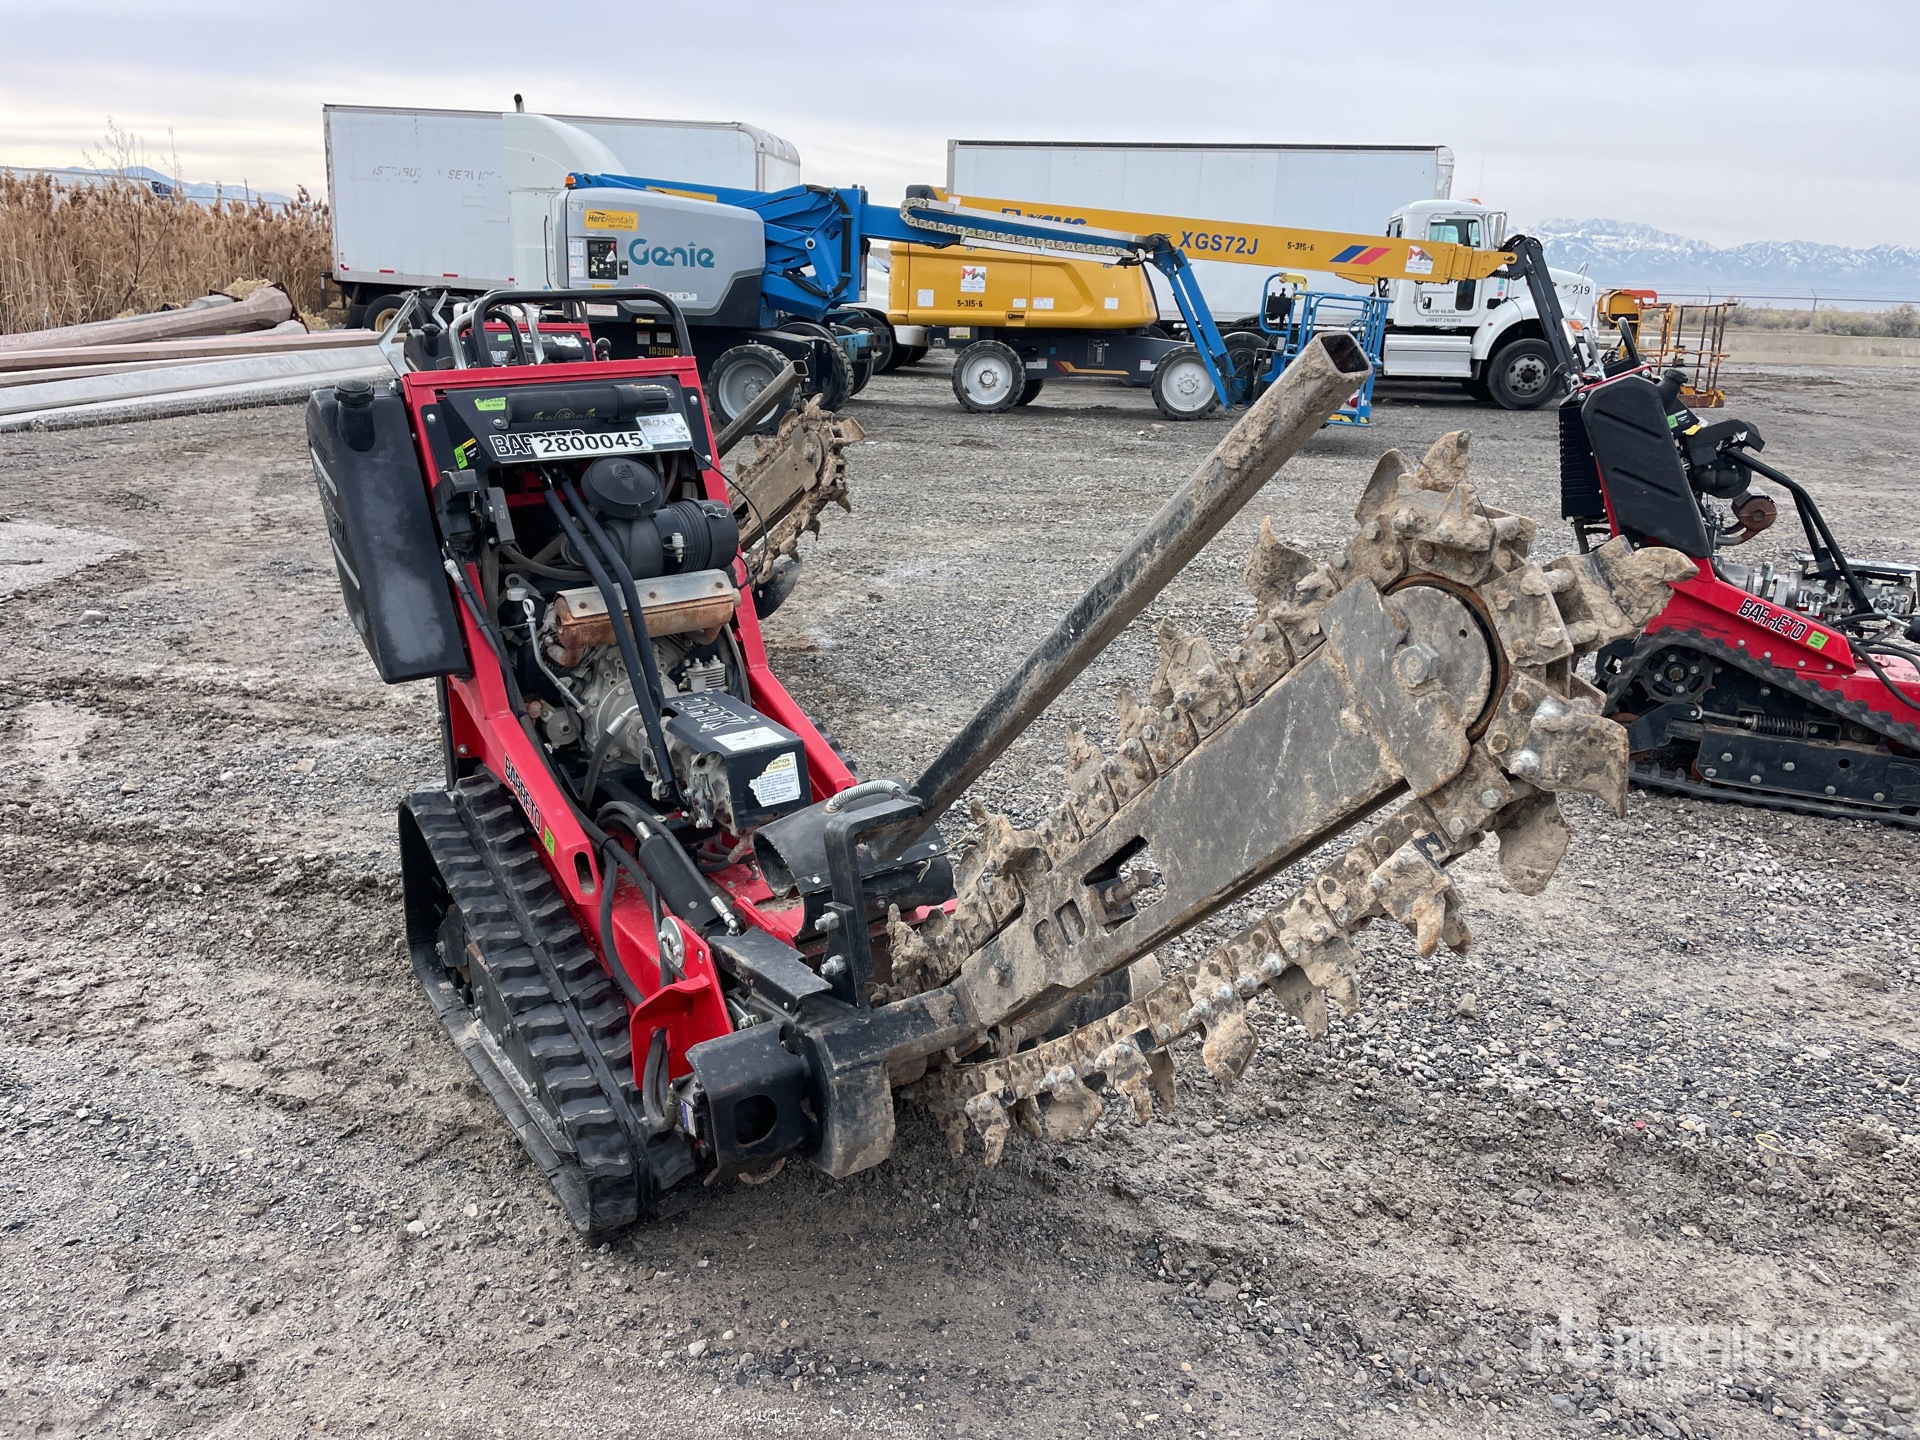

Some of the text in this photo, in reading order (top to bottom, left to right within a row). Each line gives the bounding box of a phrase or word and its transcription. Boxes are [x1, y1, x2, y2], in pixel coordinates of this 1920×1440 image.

[629, 238, 715, 269] Genie
[1179, 231, 1259, 255] XGS72J
[539, 432, 644, 453] 2800045
[504, 752, 542, 834] BARRETO
